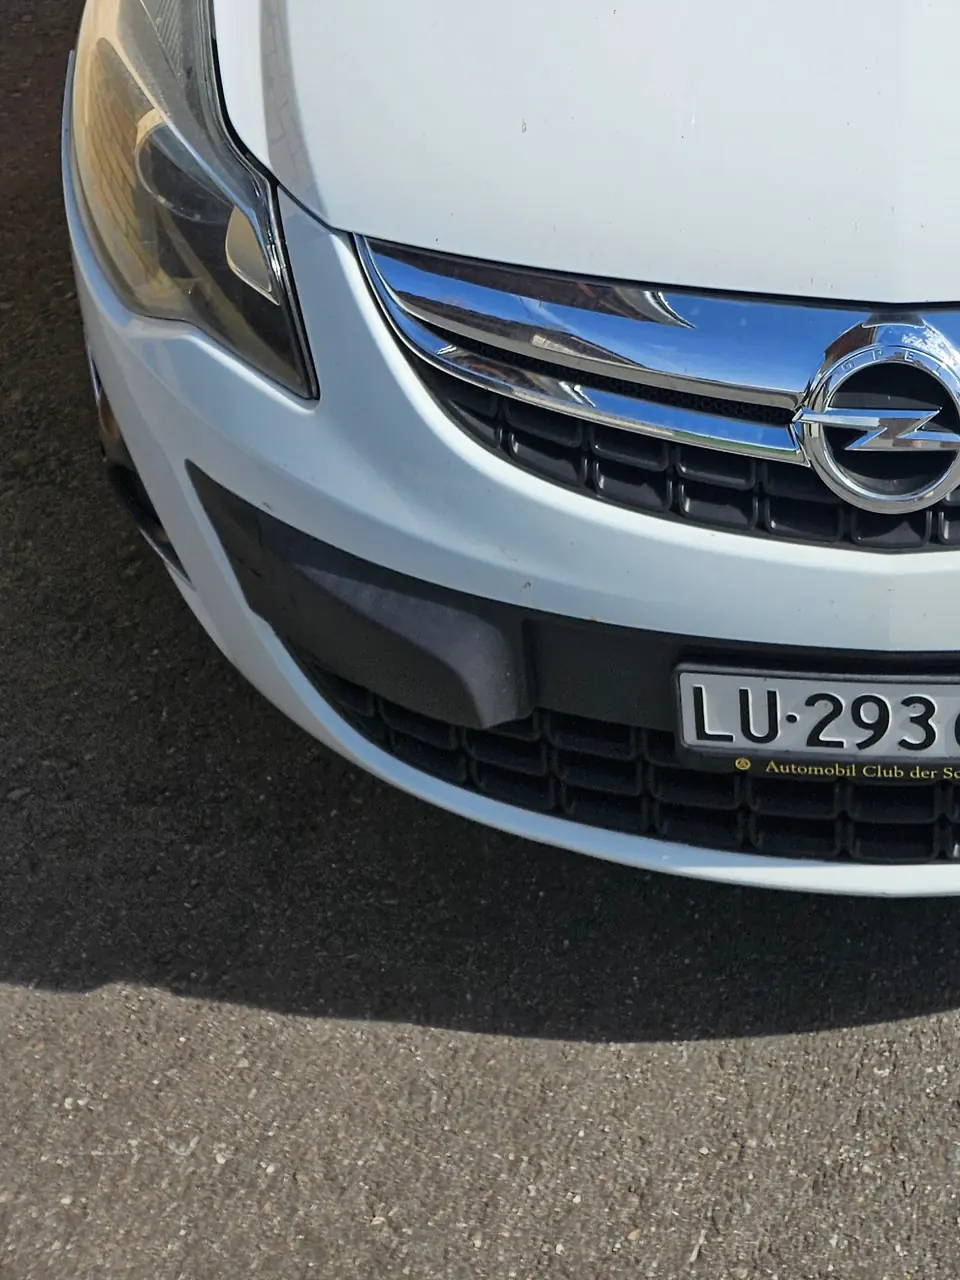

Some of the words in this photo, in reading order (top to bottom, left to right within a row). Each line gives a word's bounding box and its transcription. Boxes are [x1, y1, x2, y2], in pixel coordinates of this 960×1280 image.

[841, 350, 942, 376] OPEL
[765, 760, 856, 777] Automobil
[862, 765, 904, 778] Club
[909, 766, 938, 779] der
